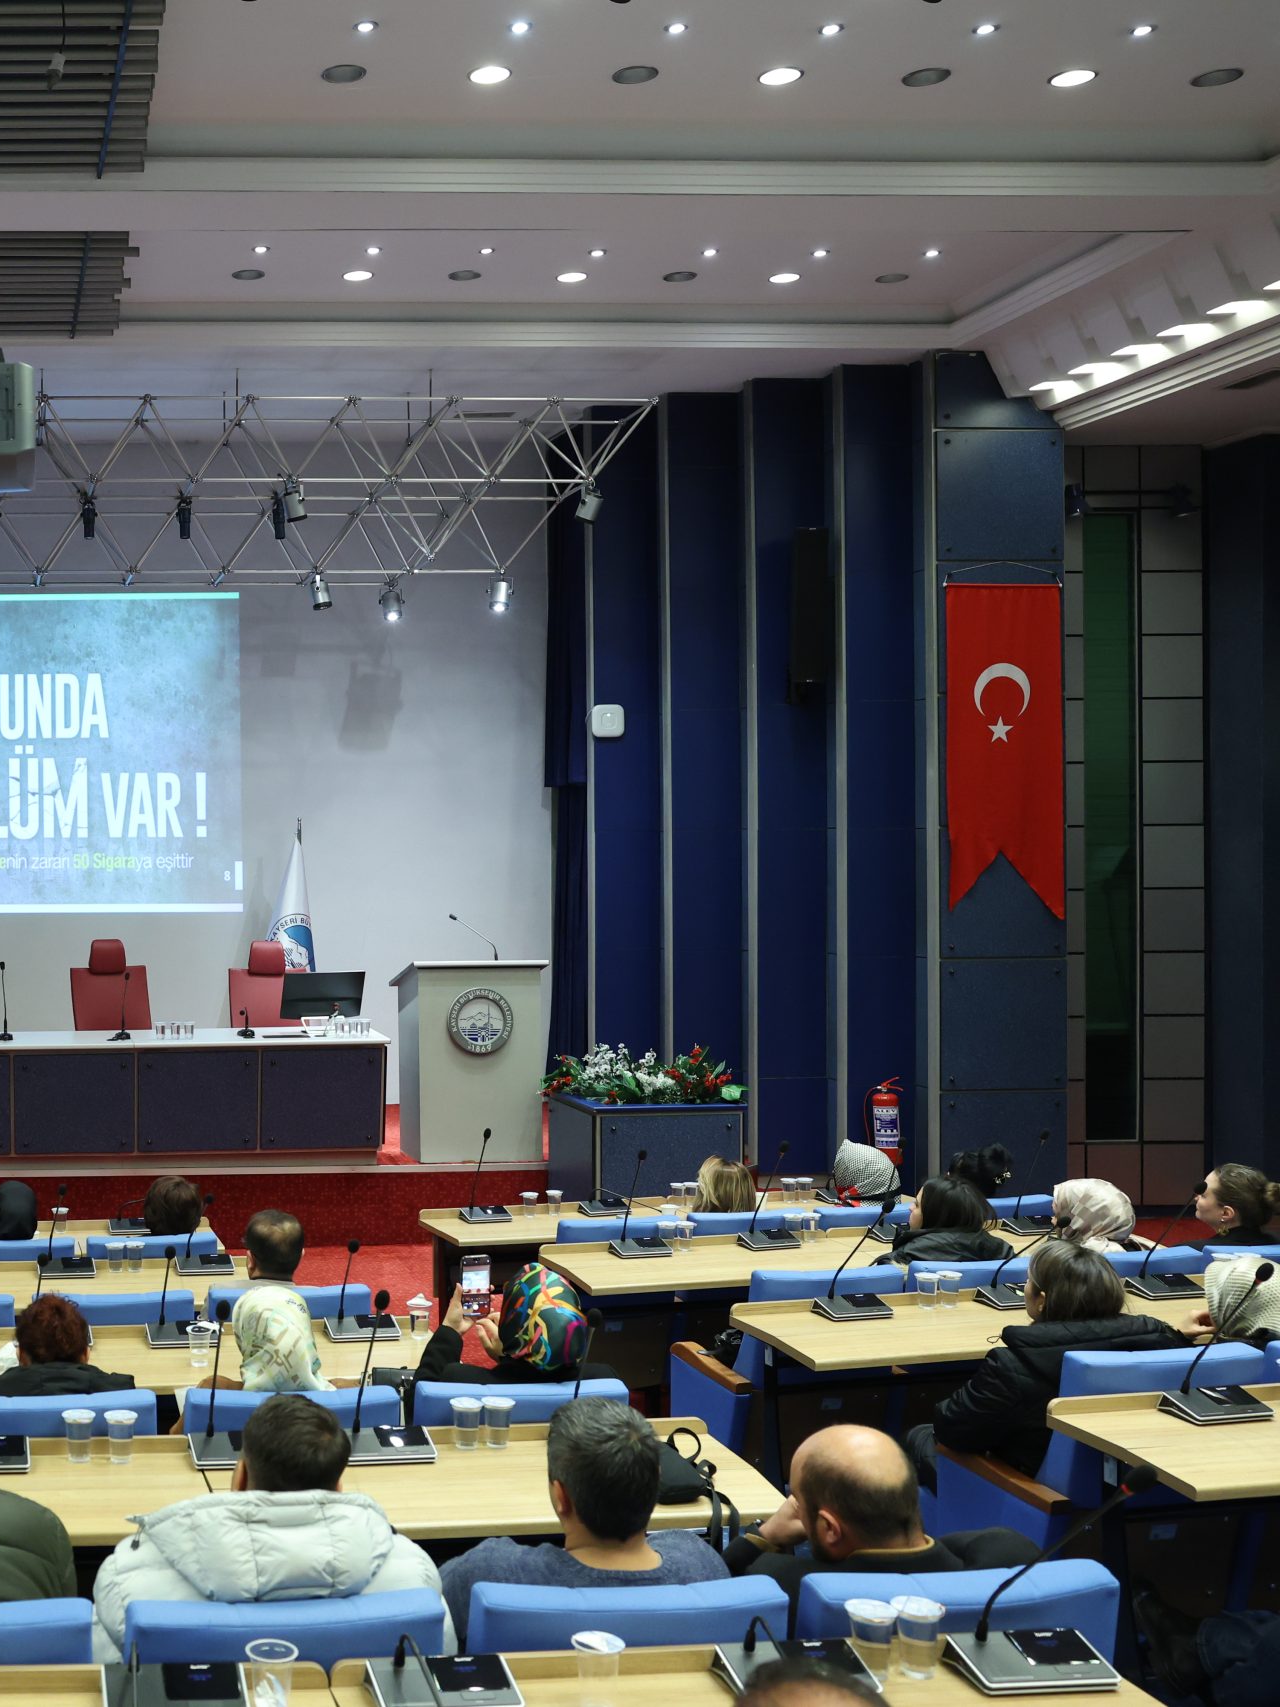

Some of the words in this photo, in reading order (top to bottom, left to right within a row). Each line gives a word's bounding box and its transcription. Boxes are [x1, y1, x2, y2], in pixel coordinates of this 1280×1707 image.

[101, 772, 184, 838] VAR
[73, 854, 90, 869] 50
[93, 852, 153, 872] Sigaraya
[156, 852, 194, 873] eşittir
[223, 870, 231, 881] 8
[471, 1043, 492, 1053] 1869
